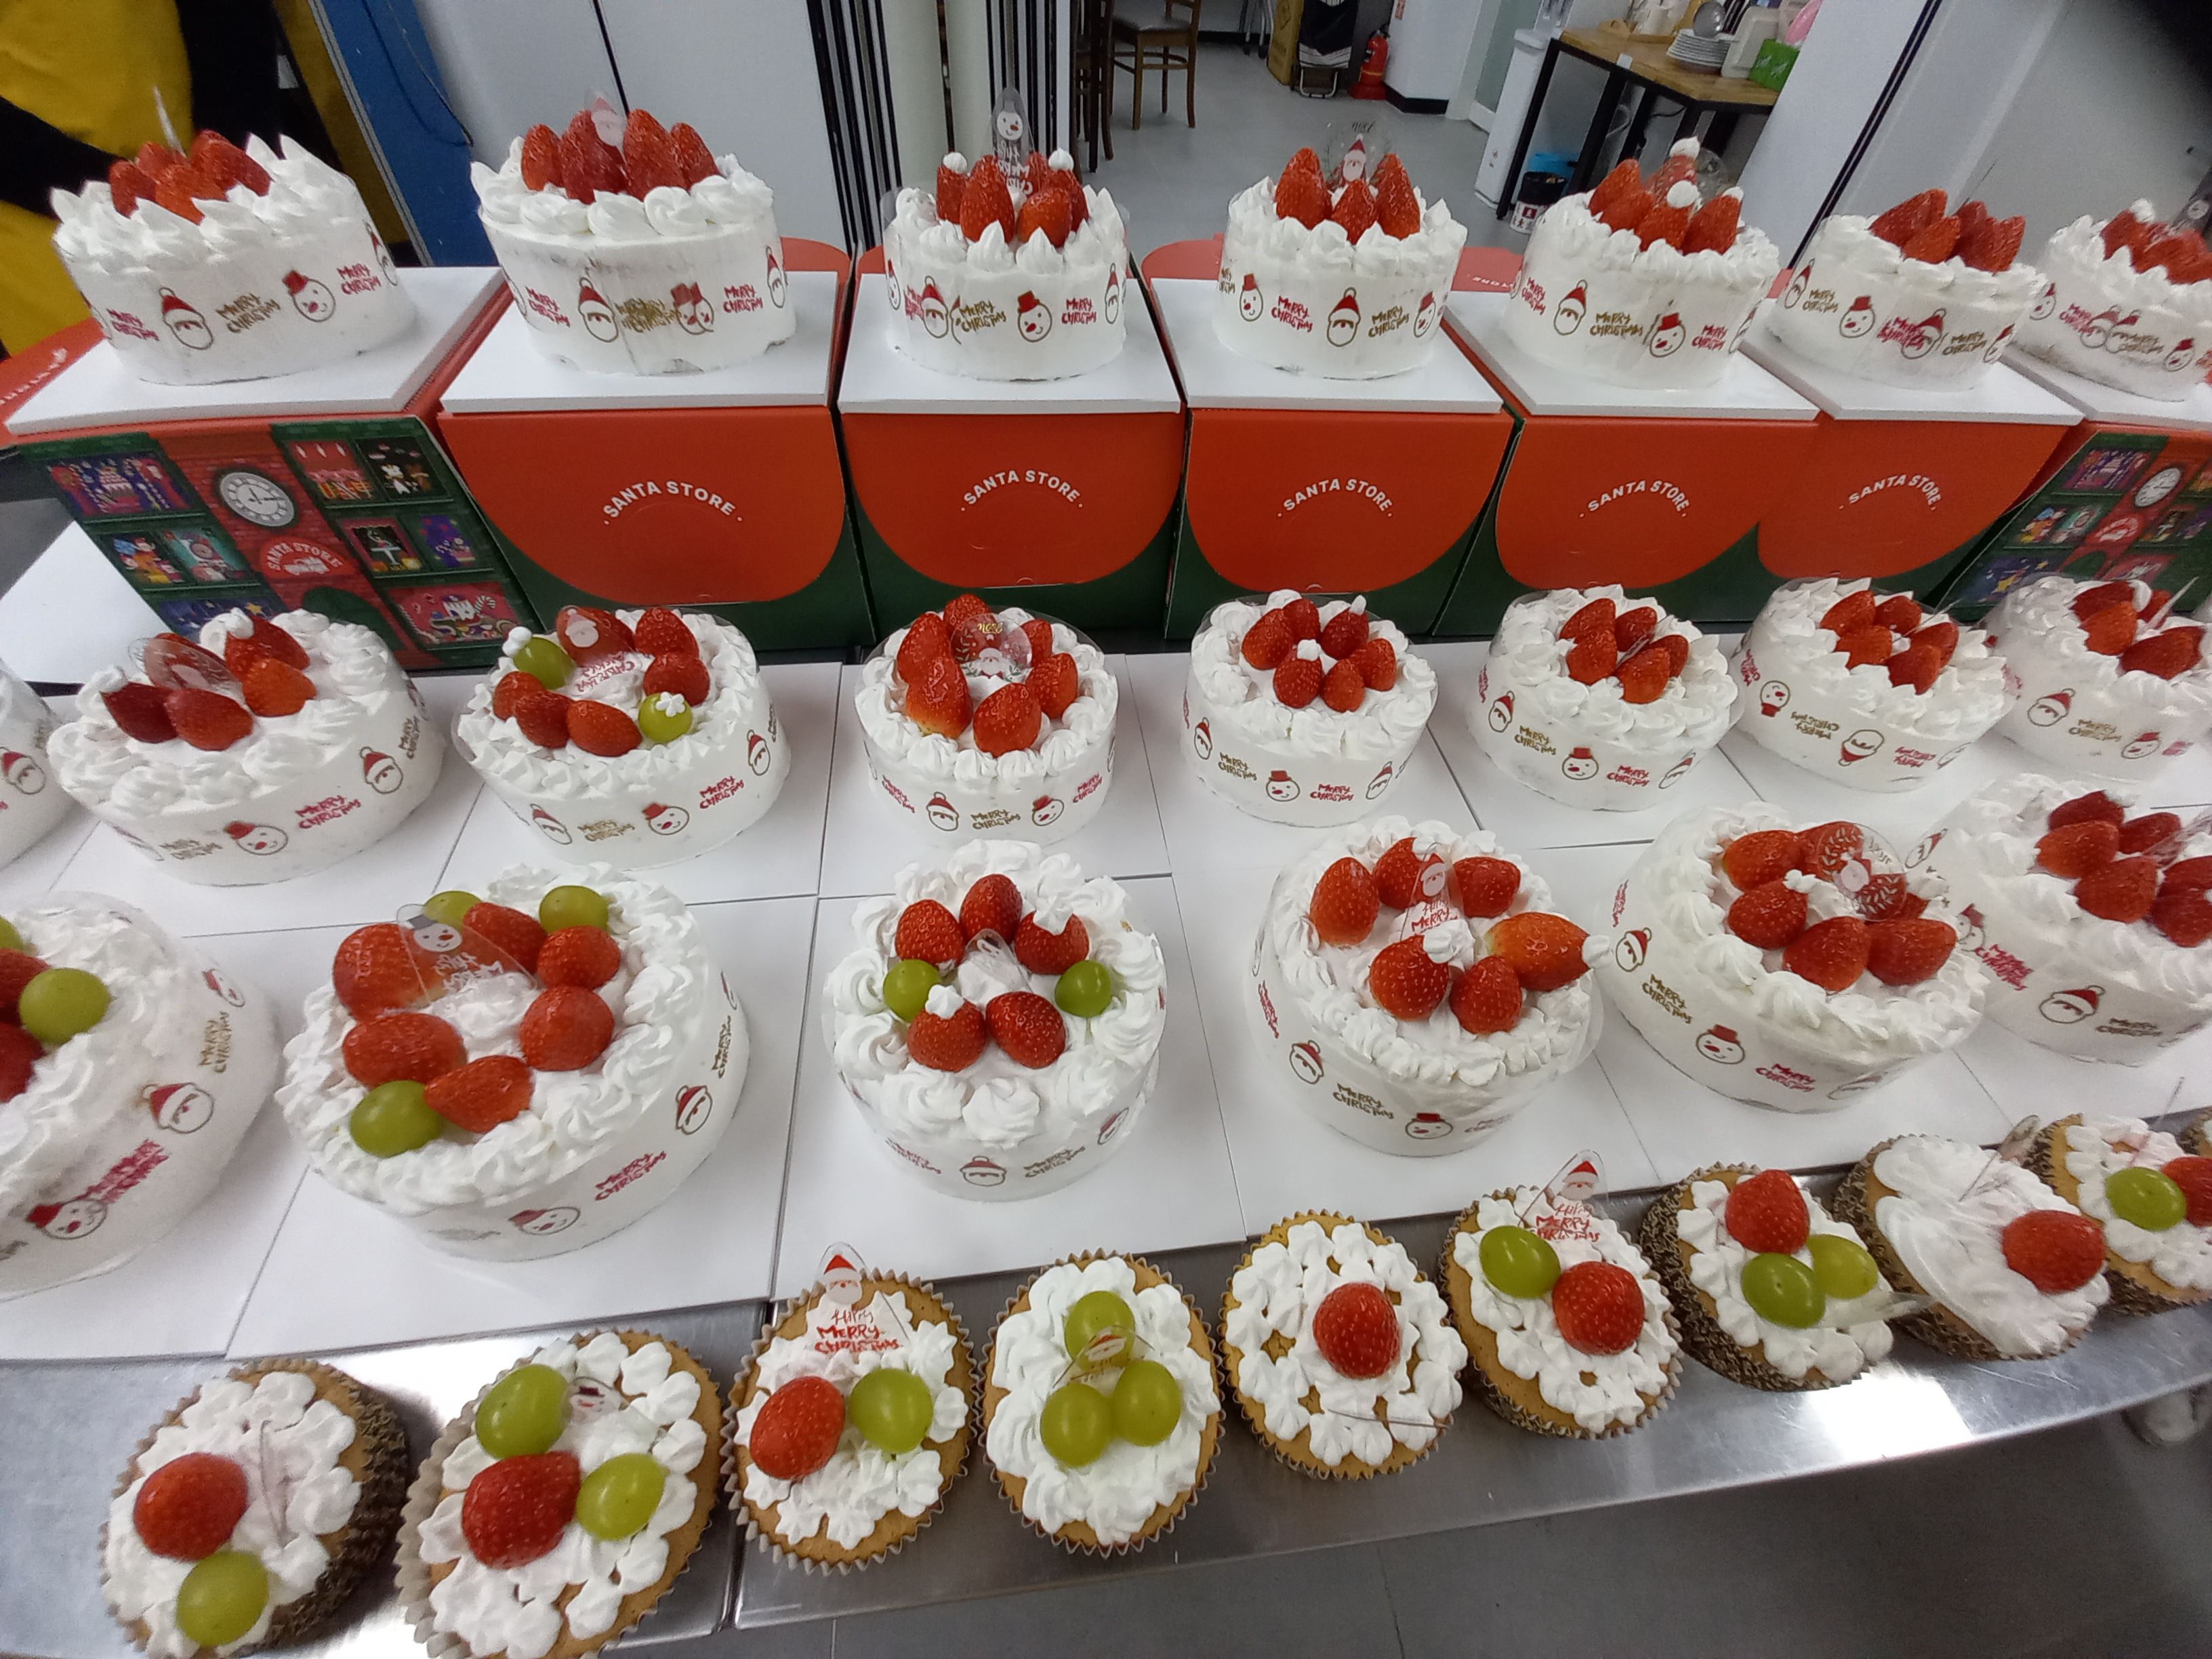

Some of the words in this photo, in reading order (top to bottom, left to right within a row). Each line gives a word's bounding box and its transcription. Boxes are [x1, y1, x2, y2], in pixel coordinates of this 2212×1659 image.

[604, 480, 661, 518] SANTA
[665, 480, 735, 517] STORE
[964, 470, 1019, 506] SANTA
[1025, 470, 1080, 503] STORE
[1285, 478, 1340, 511] SANTA
[1345, 478, 1393, 512] STORE
[1588, 480, 1647, 512] SANTA
[1650, 480, 1689, 514] STORE
[1848, 474, 1906, 506] SANTA
[1908, 474, 1942, 506] STORE
